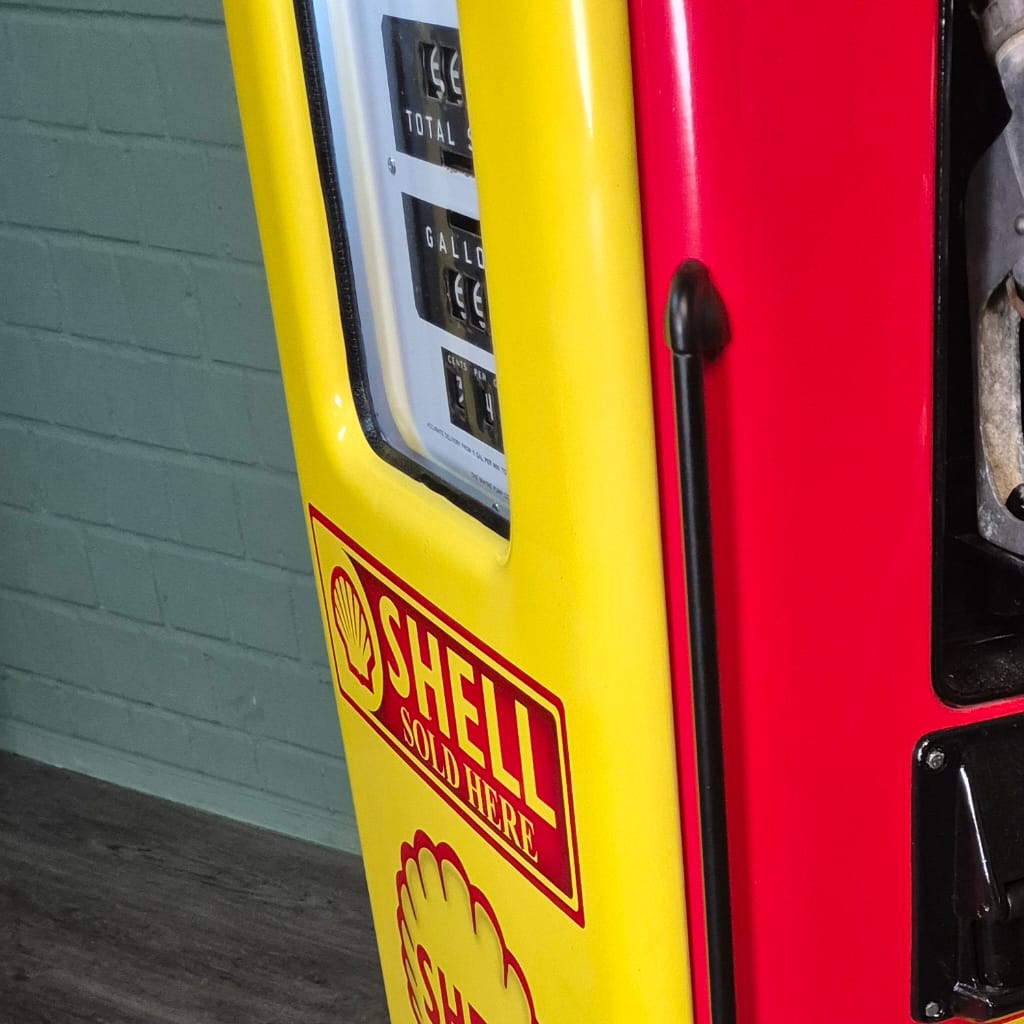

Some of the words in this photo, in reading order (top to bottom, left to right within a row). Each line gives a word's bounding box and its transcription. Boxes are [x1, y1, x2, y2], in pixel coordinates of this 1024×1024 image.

[405, 109, 456, 146] TOTAL
[447, 355, 468, 371] CENTS
[379, 595, 556, 829] SHELL
[400, 706, 461, 789] SOLD
[464, 766, 538, 863] HERE
